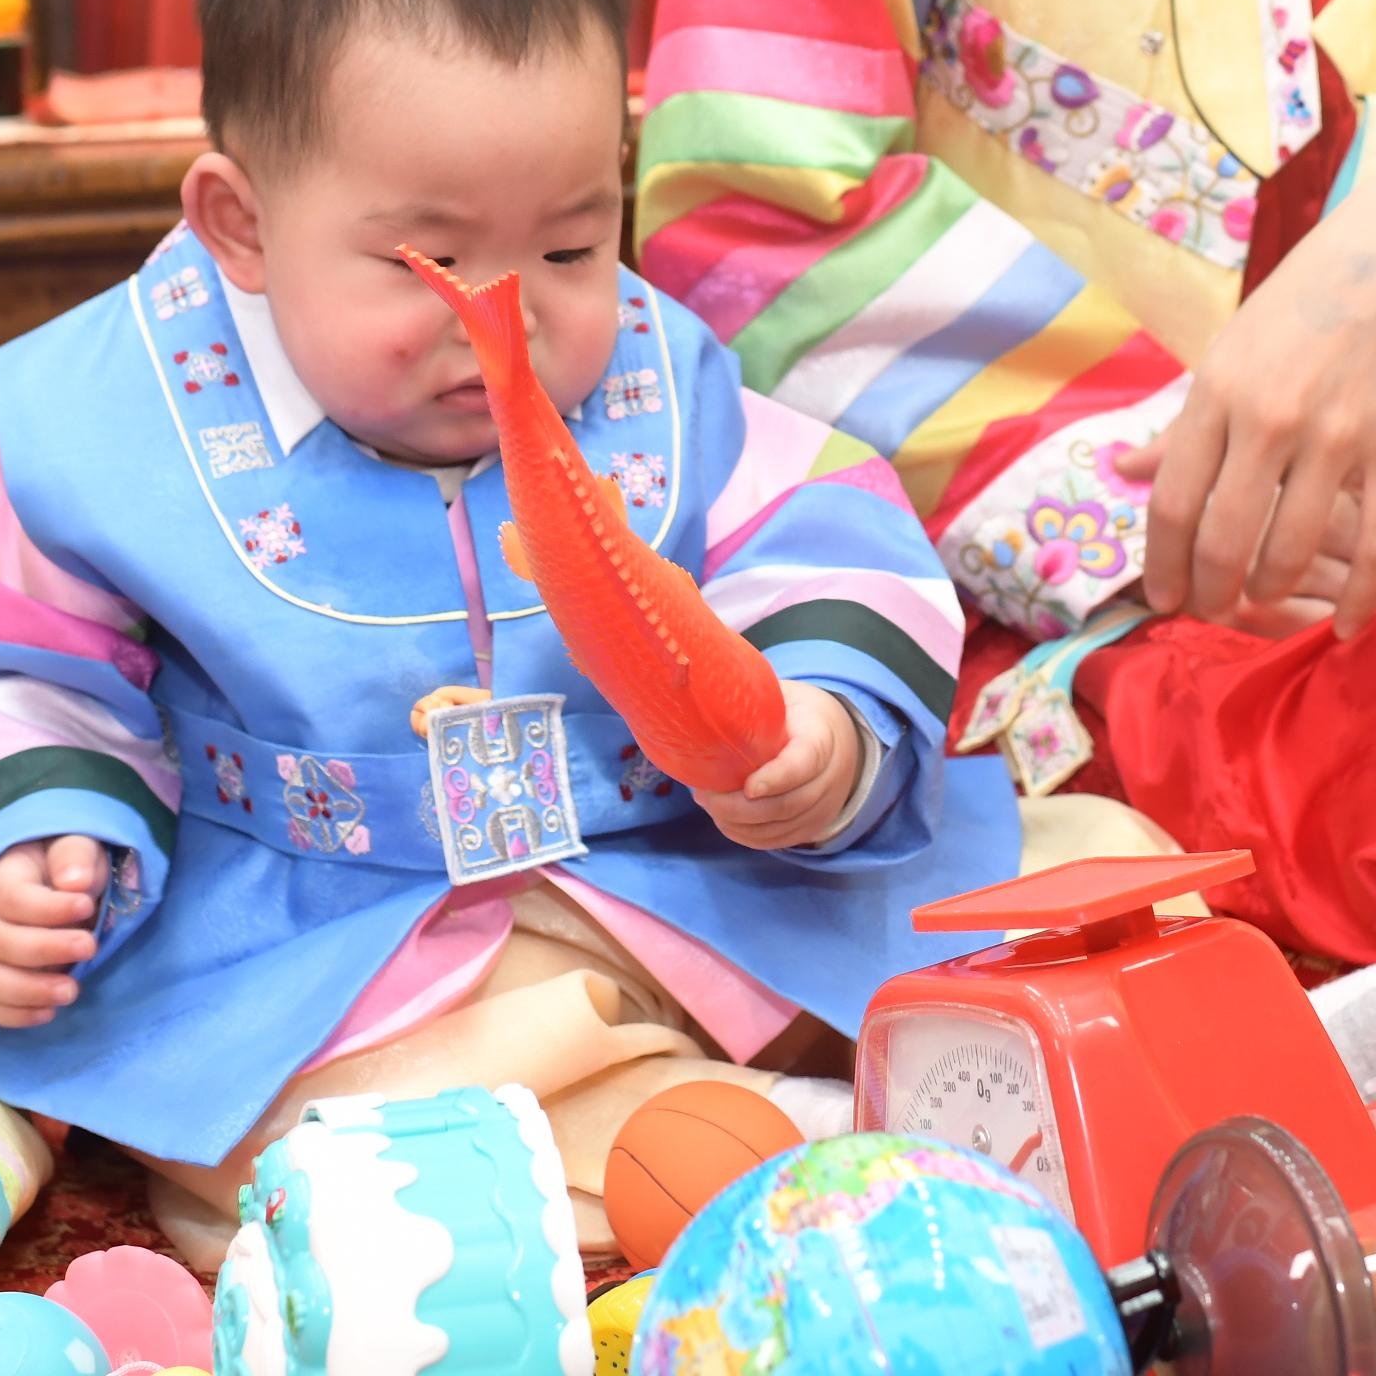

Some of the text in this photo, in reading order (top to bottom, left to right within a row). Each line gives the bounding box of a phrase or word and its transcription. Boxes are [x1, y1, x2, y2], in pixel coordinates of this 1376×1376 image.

[990, 1072, 1003, 1084] 100
[943, 1081, 956, 1093] 300
[1006, 1083, 1020, 1095] 200
[919, 1119, 932, 1130] 100
